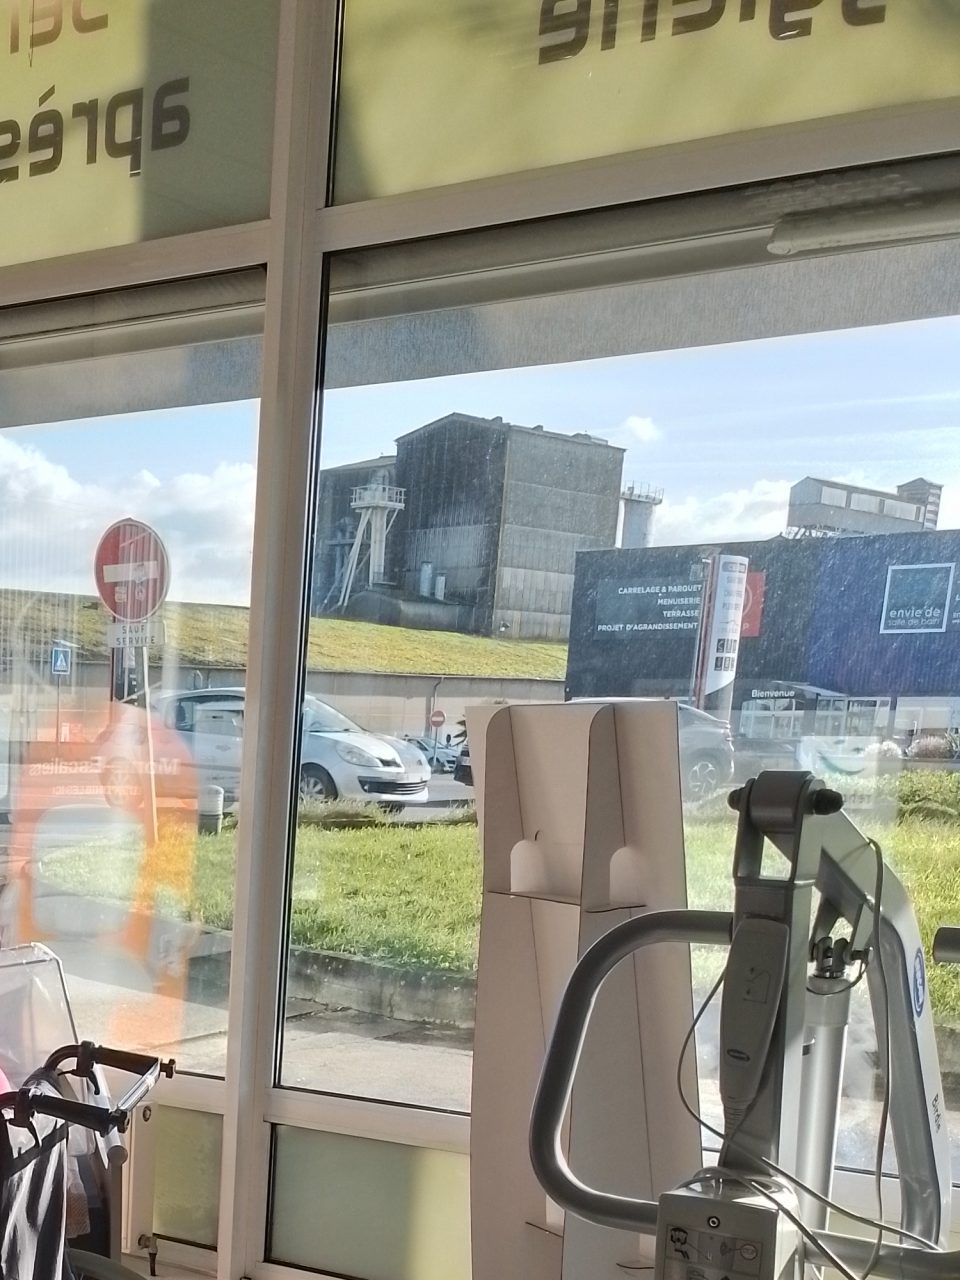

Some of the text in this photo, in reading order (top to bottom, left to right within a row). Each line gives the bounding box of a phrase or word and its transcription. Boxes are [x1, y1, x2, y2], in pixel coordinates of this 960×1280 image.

[618, 586, 660, 594] CARRELAGE
[668, 584, 702, 593] PARQUET
[657, 597, 701, 605] MENUISERIE
[889, 607, 941, 618] envie de
[121, 625, 145, 634] SAUF
[626, 622, 699, 631] D'AGRANDISSEMENT
[751, 689, 795, 698] Bienvenue
